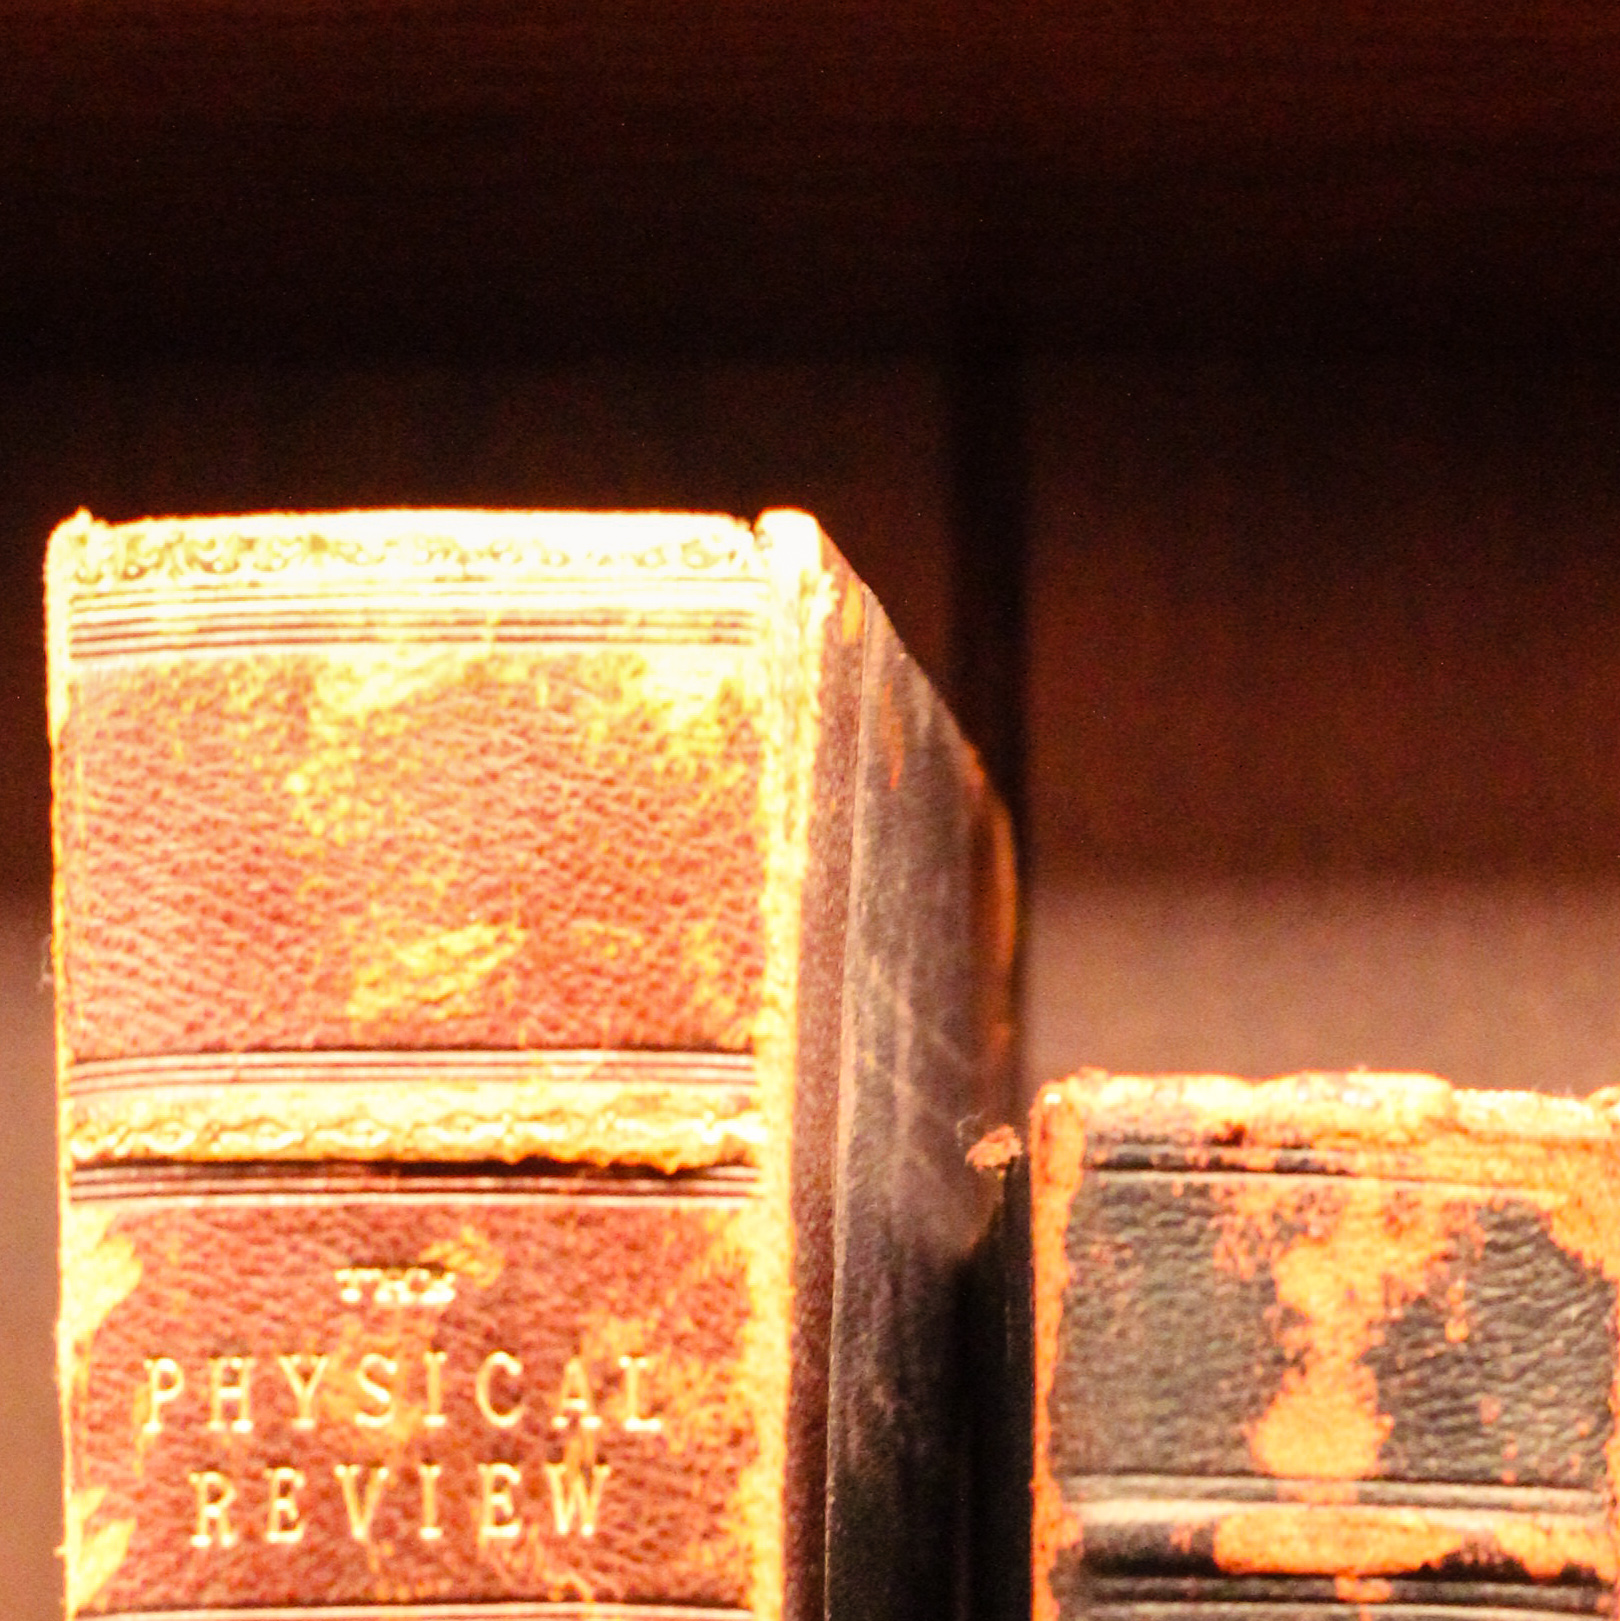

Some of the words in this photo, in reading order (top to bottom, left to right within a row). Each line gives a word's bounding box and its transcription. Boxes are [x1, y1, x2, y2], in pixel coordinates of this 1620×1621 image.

[334, 1267, 456, 1304] THE
[143, 1349, 664, 1434] PHYSICAL
[188, 1461, 612, 1549] REVIEW
